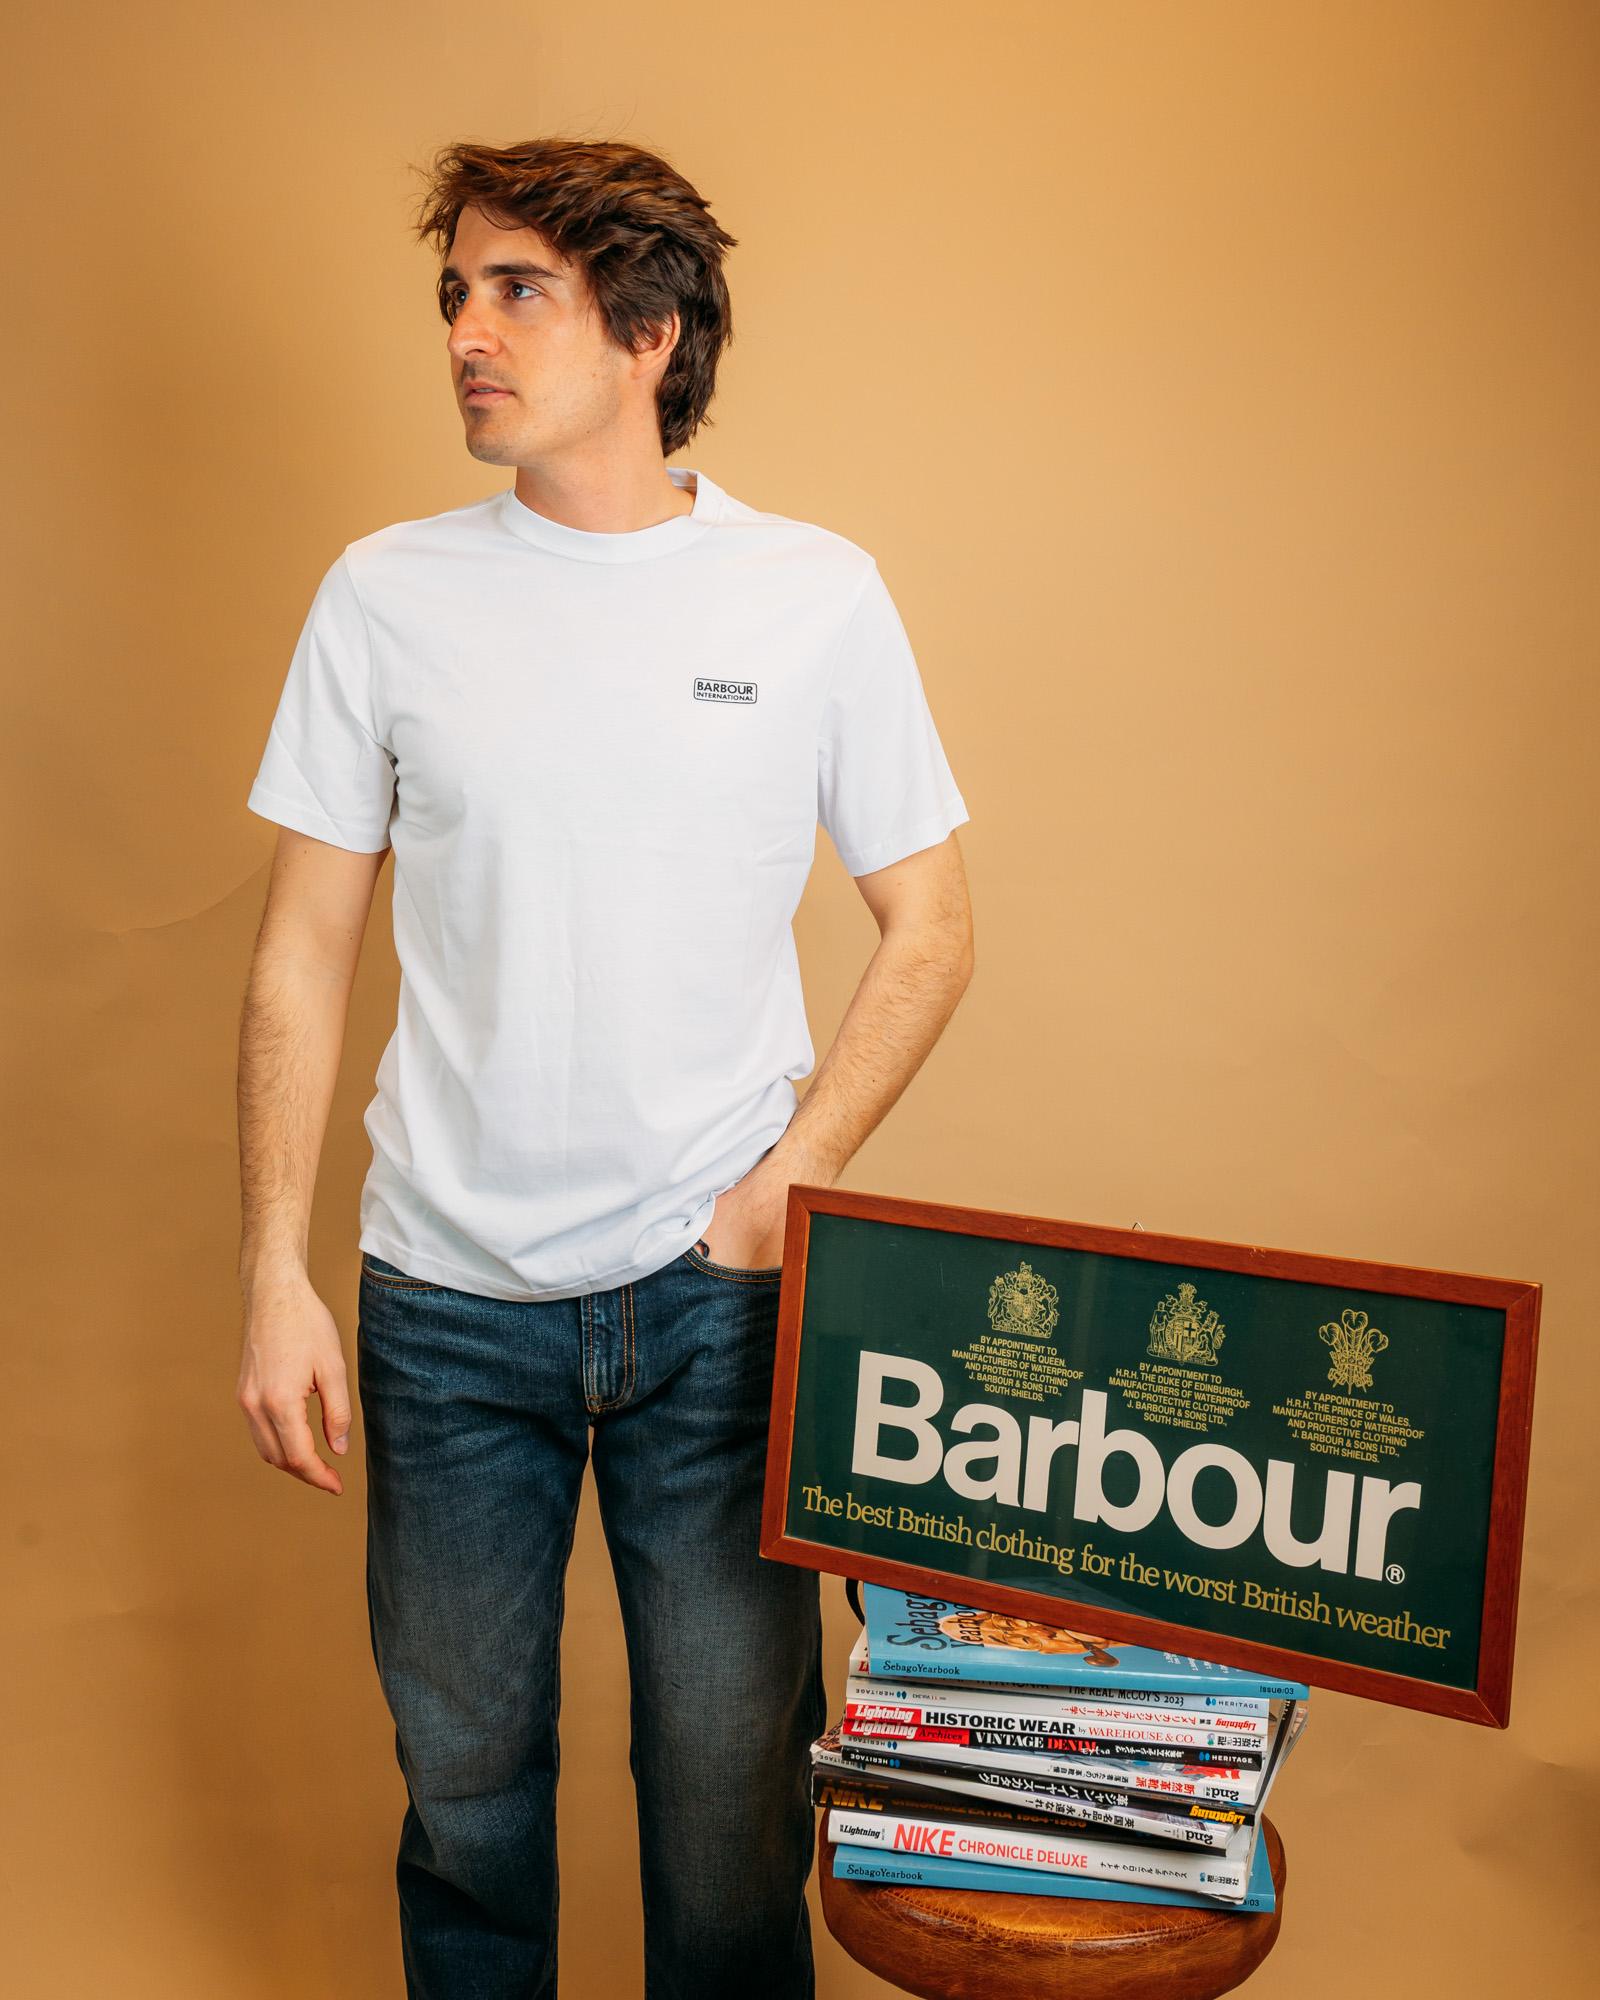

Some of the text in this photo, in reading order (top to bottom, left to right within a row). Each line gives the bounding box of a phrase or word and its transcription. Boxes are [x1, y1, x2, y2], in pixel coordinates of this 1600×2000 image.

[696, 691, 754, 702] INTERNATIONAL
[697, 681, 754, 695] BARBOUR
[969, 1343, 1067, 1368] HER MAJESTY THE QUEEN.
[980, 1336, 1058, 1356] BY APPOINTMENT TO
[952, 1350, 1084, 1380] MANUFACTURERS OF WATERPROOF
[965, 1362, 1069, 1387] AND PROTECTIVE CLOTHING
[1140, 1362, 1222, 1384] BY APPOINTMENT TO
[968, 1372, 976, 1380] J.
[976, 1373, 1014, 1387] BARBOUR
[1014, 1380, 1021, 1388] &
[1022, 1381, 1043, 1392] SONS
[1116, 1368, 1245, 1398] H.R.H. THE DUKE OF EDINBURGH.
[984, 1384, 1045, 1402] SOUTH SHIELDS.
[1108, 1376, 1251, 1410] MANUFACTURERS OF WATERPROOF
[1305, 1390, 1394, 1414] BY APPOINTMENT TO
[1122, 1390, 1234, 1417] AND PROTECTIVE CLOTHING
[1127, 1400, 1134, 1408] J.
[1135, 1400, 1176, 1416] BARBOUR
[1176, 1408, 1182, 1417] &
[1184, 1410, 1207, 1422] SONS
[1286, 1397, 1412, 1428] H.R.H. THE PRINCE OF WALES.
[1144, 1412, 1208, 1432] SOUTH SHIELDS.
[1272, 1405, 1425, 1440] MANUFACTURERS OF WATERPROOF
[1287, 1418, 1407, 1448] AND PROTECTIVE CLOTHING
[1292, 1430, 1300, 1438] J.
[1300, 1430, 1344, 1446] BARBOUR
[1345, 1438, 1352, 1448] &
[1353, 1439, 1378, 1453] SONS
[1310, 1442, 1380, 1464] SOUTH SHIELDS.
[851, 1350, 1422, 1581] Barbour
[802, 1486, 1451, 1650] The best British clothing for the worst British weather
[856, 1688, 894, 1697] HERITAGE
[1089, 1688, 1114, 1698] REAL
[1164, 1695, 1184, 1707] 2023
[855, 1704, 914, 1723] Lightning
[1218, 1700, 1259, 1710] HERITAGE
[851, 1720, 918, 1740] Lightning
[926, 1712, 1196, 1744] HISTORIC WEAR by WAREHOUSE & CO.
[1216, 1718, 1256, 1731] Lightning
[848, 1736, 886, 1746] HERITAGE
[975, 1732, 1098, 1752] VINTAGE DENIM
[850, 1753, 888, 1766] HERITAGE
[1211, 1754, 1253, 1764] HERITAGE
[1211, 1787, 1240, 1802] 2nd
[1190, 1805, 1246, 1825] Lightning
[844, 1825, 881, 1840] Lightning
[1185, 1830, 1214, 1845] 2nd
[893, 1823, 956, 1857] NIKE
[958, 1839, 1034, 1862] CHRONICLE
[1037, 1850, 1088, 1869] DELUXE
